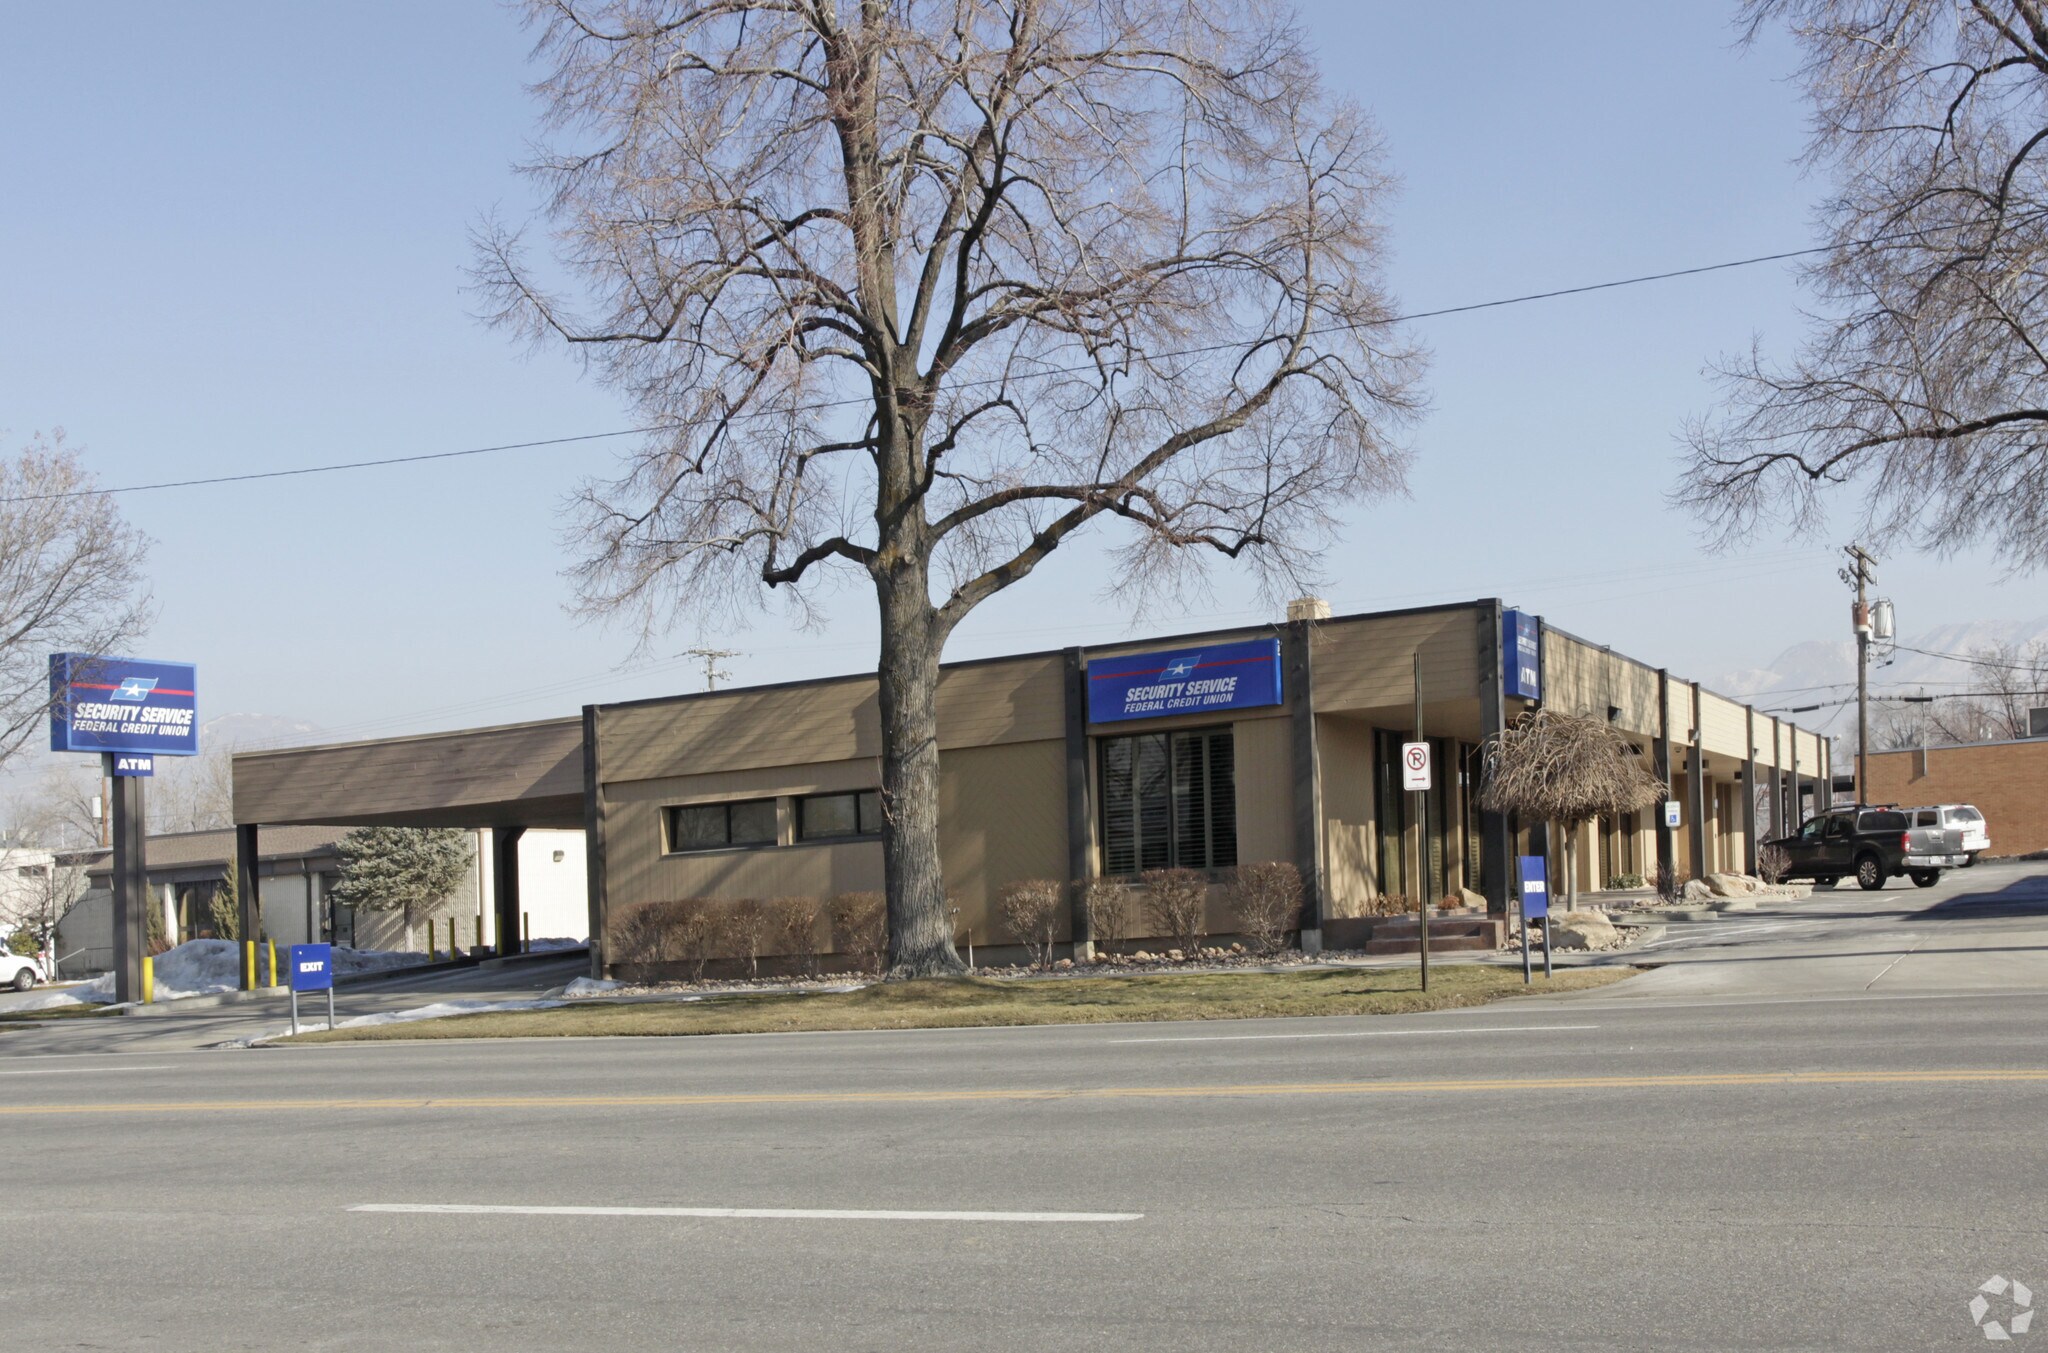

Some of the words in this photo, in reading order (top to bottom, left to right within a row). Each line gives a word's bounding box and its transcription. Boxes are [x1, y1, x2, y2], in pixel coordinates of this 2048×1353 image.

[1520, 666, 1536, 687] ATM
[1125, 683, 1185, 702] SECURITY
[1185, 677, 1237, 696] SERVICE
[1124, 700, 1164, 713] FEDERAL
[1167, 696, 1201, 709] CREDIT
[1203, 693, 1233, 705] UNION
[74, 702, 140, 722] SECURITY
[140, 706, 194, 725] SERVICE
[72, 720, 118, 733] FEDERAL
[120, 723, 157, 735] CREDIT
[158, 725, 189, 737] UNION
[118, 758, 151, 770] ATM
[1524, 880, 1545, 893] ENTER
[300, 961, 323, 972] EXIT
